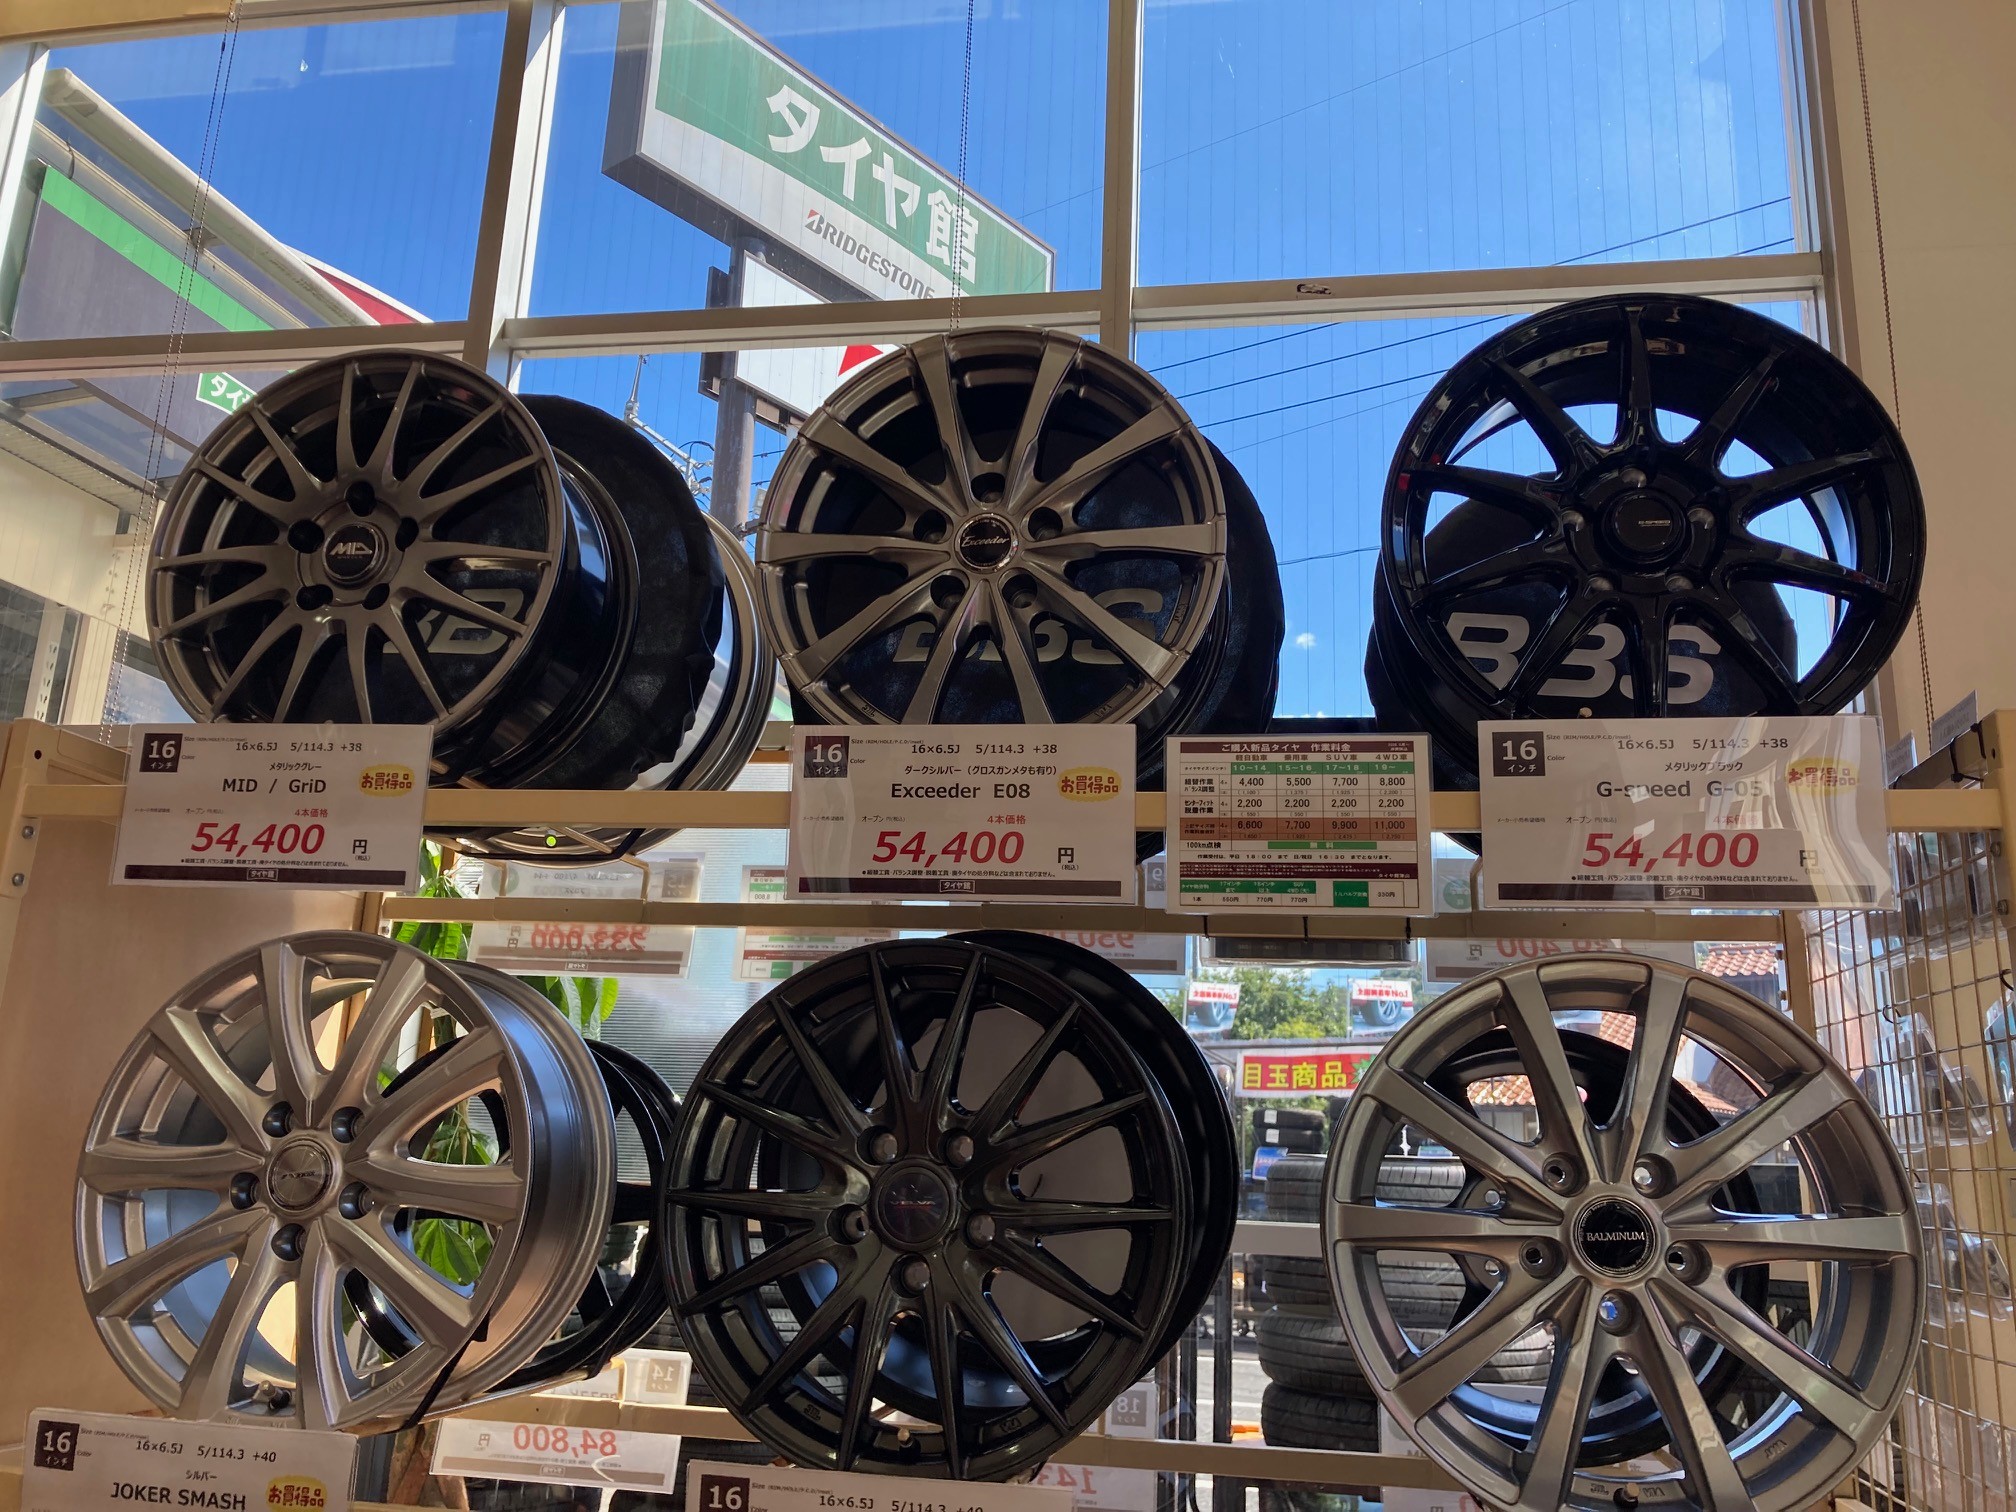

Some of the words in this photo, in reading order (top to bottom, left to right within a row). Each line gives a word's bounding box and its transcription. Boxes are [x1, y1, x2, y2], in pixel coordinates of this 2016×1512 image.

[766, 84, 979, 284] タイヤ館
[961, 536, 1009, 547] Exceeder
[149, 740, 175, 759] 16
[236, 742, 278, 752] 16×6.5J
[290, 742, 334, 753] 5/114.3
[341, 742, 362, 752] +38
[912, 744, 960, 754] 16×6.5J
[976, 744, 1025, 755] 5/114.3
[1033, 744, 1058, 754] +38
[1221, 743, 1300, 752] ご購入新品タイヤ
[1311, 743, 1351, 752] 作業料金
[1502, 740, 1537, 761] 16
[1617, 739, 1675, 750] 16×6.5J
[1693, 739, 1749, 751] 5/114.3
[1759, 739, 1788, 749] +38
[812, 744, 842, 763] 16
[151, 762, 172, 770] インチ
[269, 763, 321, 771] メタリックグレー
[816, 766, 841, 774] インチ
[1507, 764, 1537, 773] インチ
[222, 779, 258, 793] MID
[269, 779, 277, 794] /
[289, 779, 326, 794] GriD
[361, 772, 412, 790] お買得品
[1061, 777, 1119, 794] お買得品
[1239, 777, 1264, 787] 4,400
[1286, 777, 1311, 787] 5,500
[1333, 777, 1358, 787] 7,700
[1379, 777, 1405, 787] 8,800
[891, 783, 980, 799] Exceeder
[993, 783, 1030, 799] E08
[1597, 781, 1691, 801] G-speed
[1707, 781, 1764, 797] G-05
[1237, 799, 1262, 808] 2,200
[1285, 799, 1310, 808] 2,200
[1331, 799, 1356, 808] 2,200
[1378, 799, 1404, 808] 2,200
[294, 808, 328, 818] 4本価格
[861, 815, 883, 823] オープン
[987, 815, 1026, 825] 4本価格
[1566, 816, 1592, 824] オープン
[1237, 820, 1262, 829] 6,600
[1286, 820, 1311, 830] 7,700
[1332, 820, 1357, 830] 9,900
[1374, 820, 1405, 829] 11,000
[191, 822, 325, 857] 54,400
[352, 840, 367, 854] 円
[872, 831, 1025, 868] 54,400
[1582, 832, 1758, 873] 54,400
[1058, 848, 1075, 864] 円
[1800, 850, 1819, 867] 円
[944, 881, 971, 891] タイヤ館
[1668, 887, 1700, 897] タイヤ館
[1243, 1060, 1348, 1089] 目玉商品
[1586, 1232, 1645, 1241] BALMINUM
[43, 1430, 72, 1453] 16
[197, 1446, 245, 1461] 5/114.3
[253, 1451, 276, 1463] +40
[45, 1457, 70, 1467] インチ
[186, 1470, 218, 1481] シルバー
[110, 1483, 170, 1505] JOKER
[178, 1489, 246, 1511] SMASH
[268, 1486, 324, 1507] お買得品
[708, 1486, 742, 1510] 16
[819, 1495, 874, 1510] 16×6.5J
